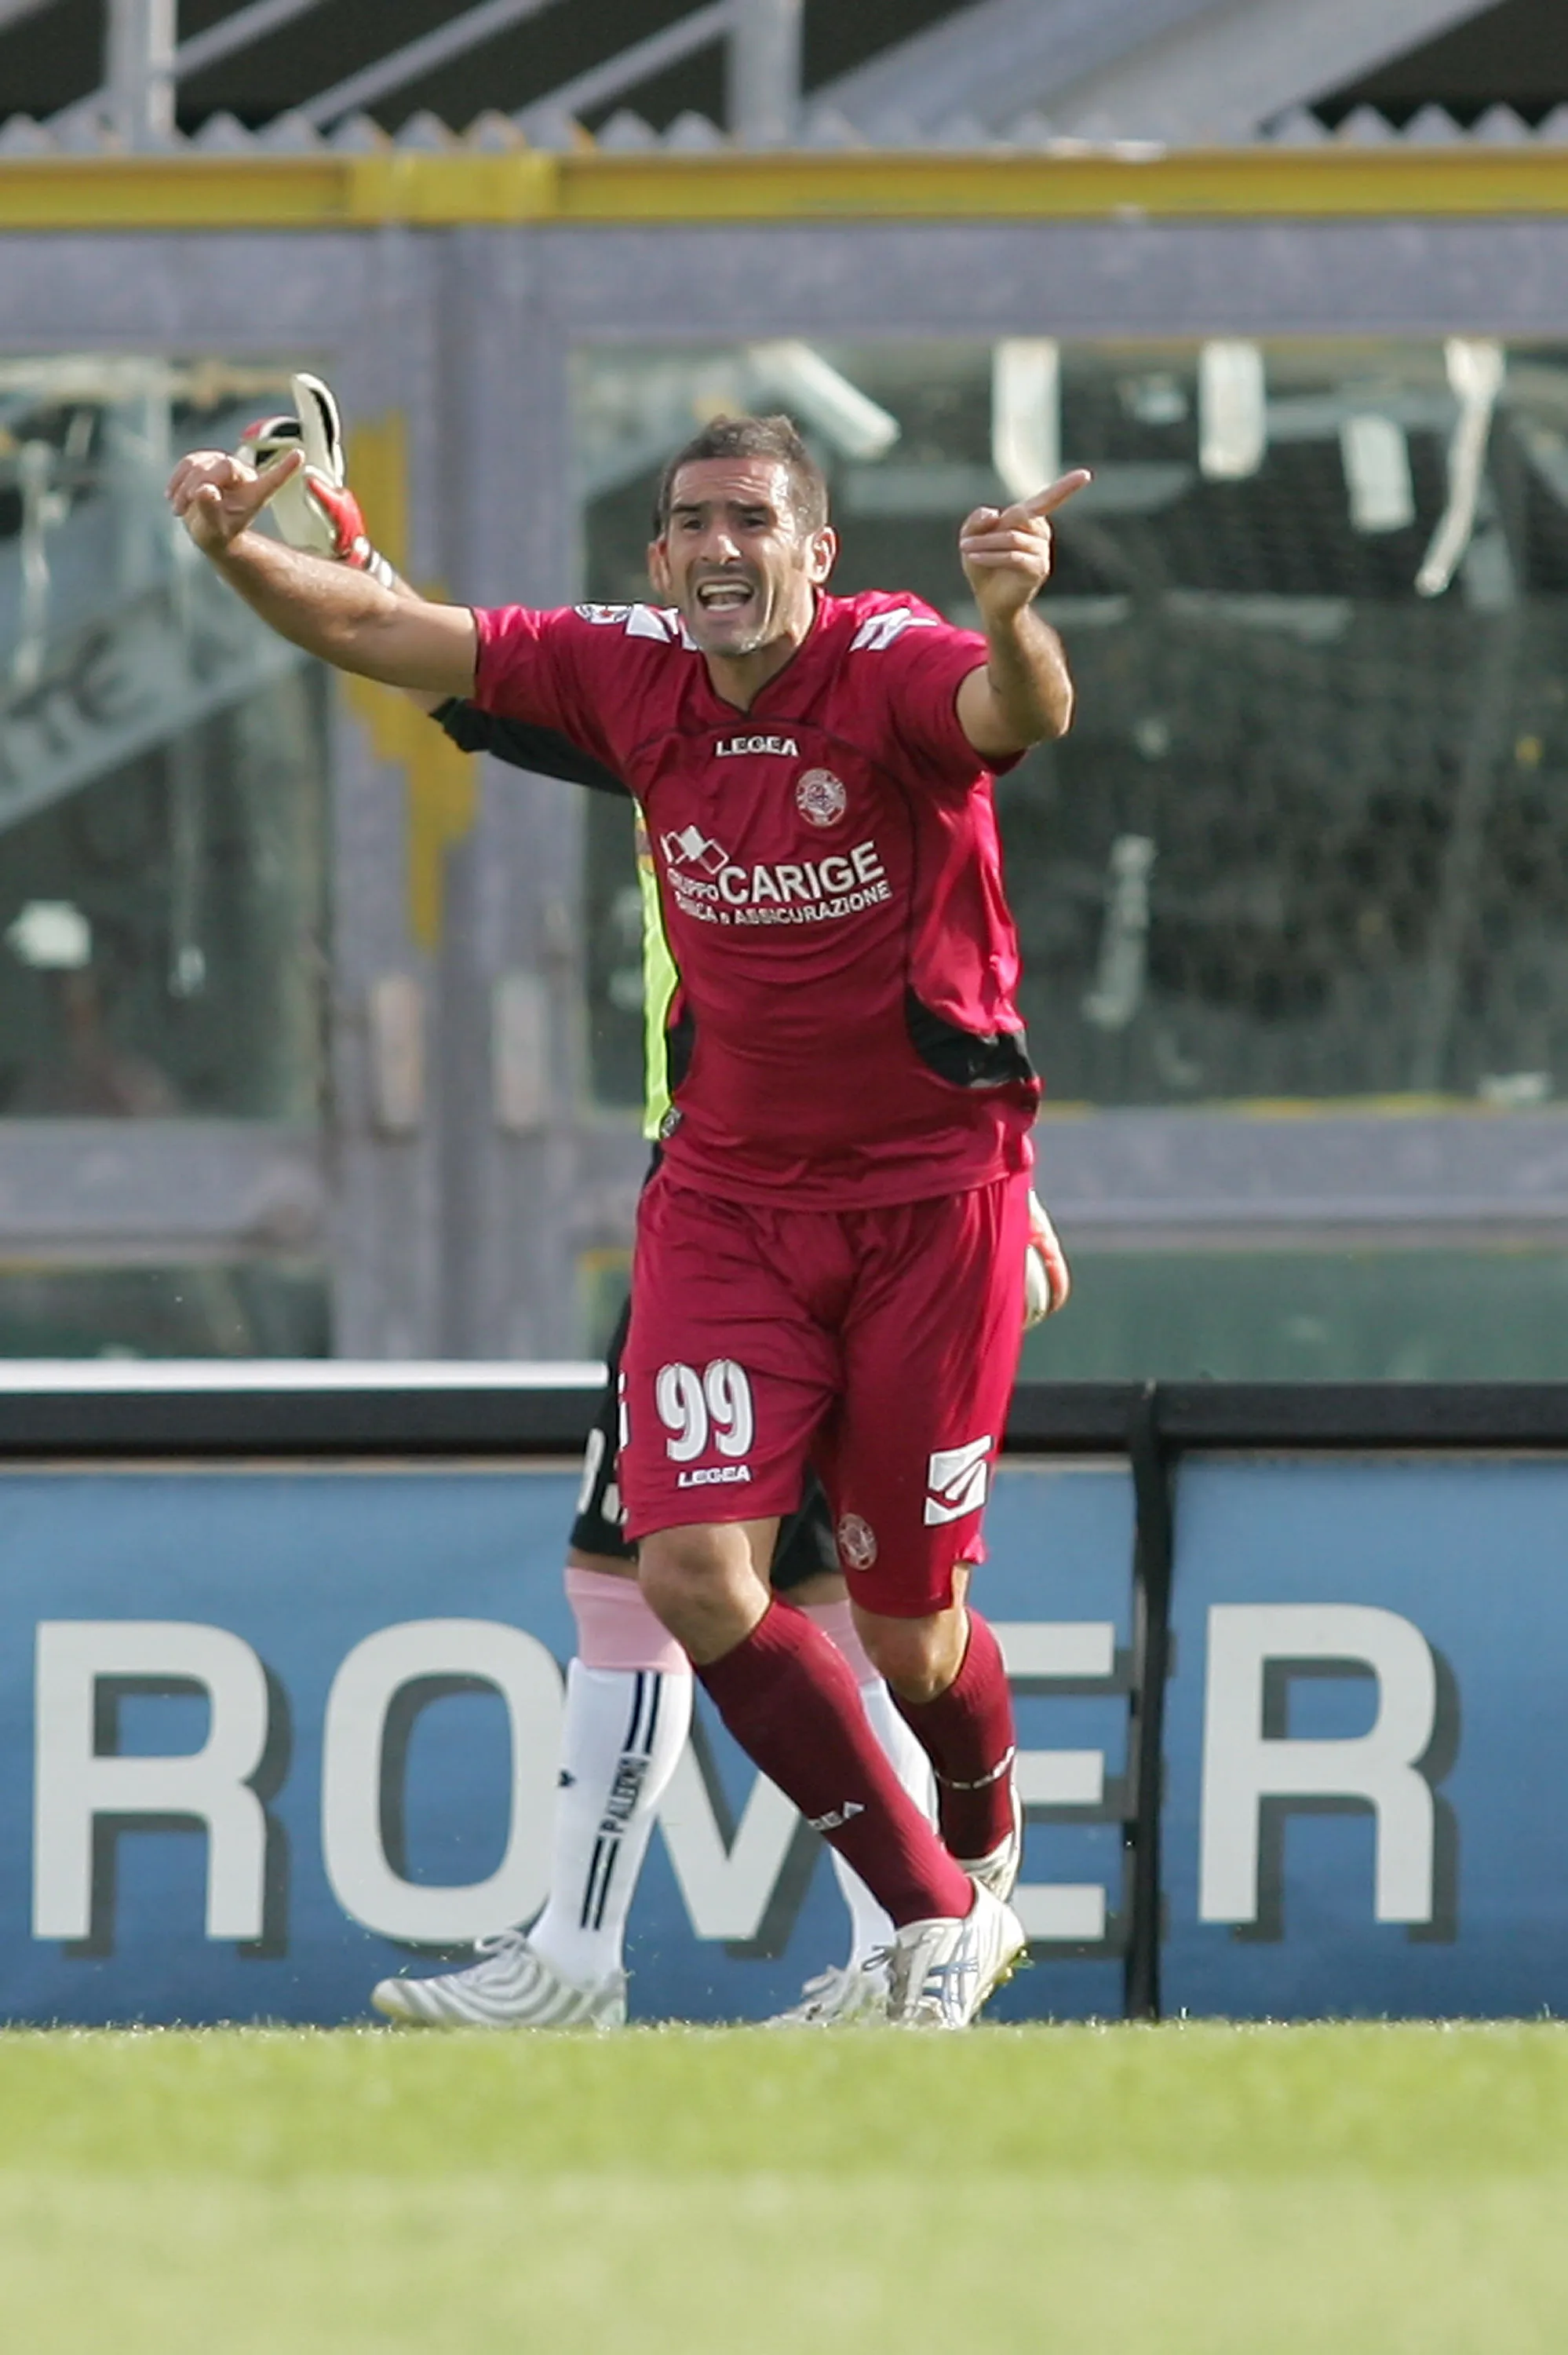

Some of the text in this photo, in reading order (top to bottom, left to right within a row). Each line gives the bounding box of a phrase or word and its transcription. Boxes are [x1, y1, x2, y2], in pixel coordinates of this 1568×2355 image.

[716, 736, 800, 758] LEGEA
[718, 840, 886, 905] CARIGE
[655, 1359, 754, 1462] 99
[677, 1465, 751, 1488] LEGEA
